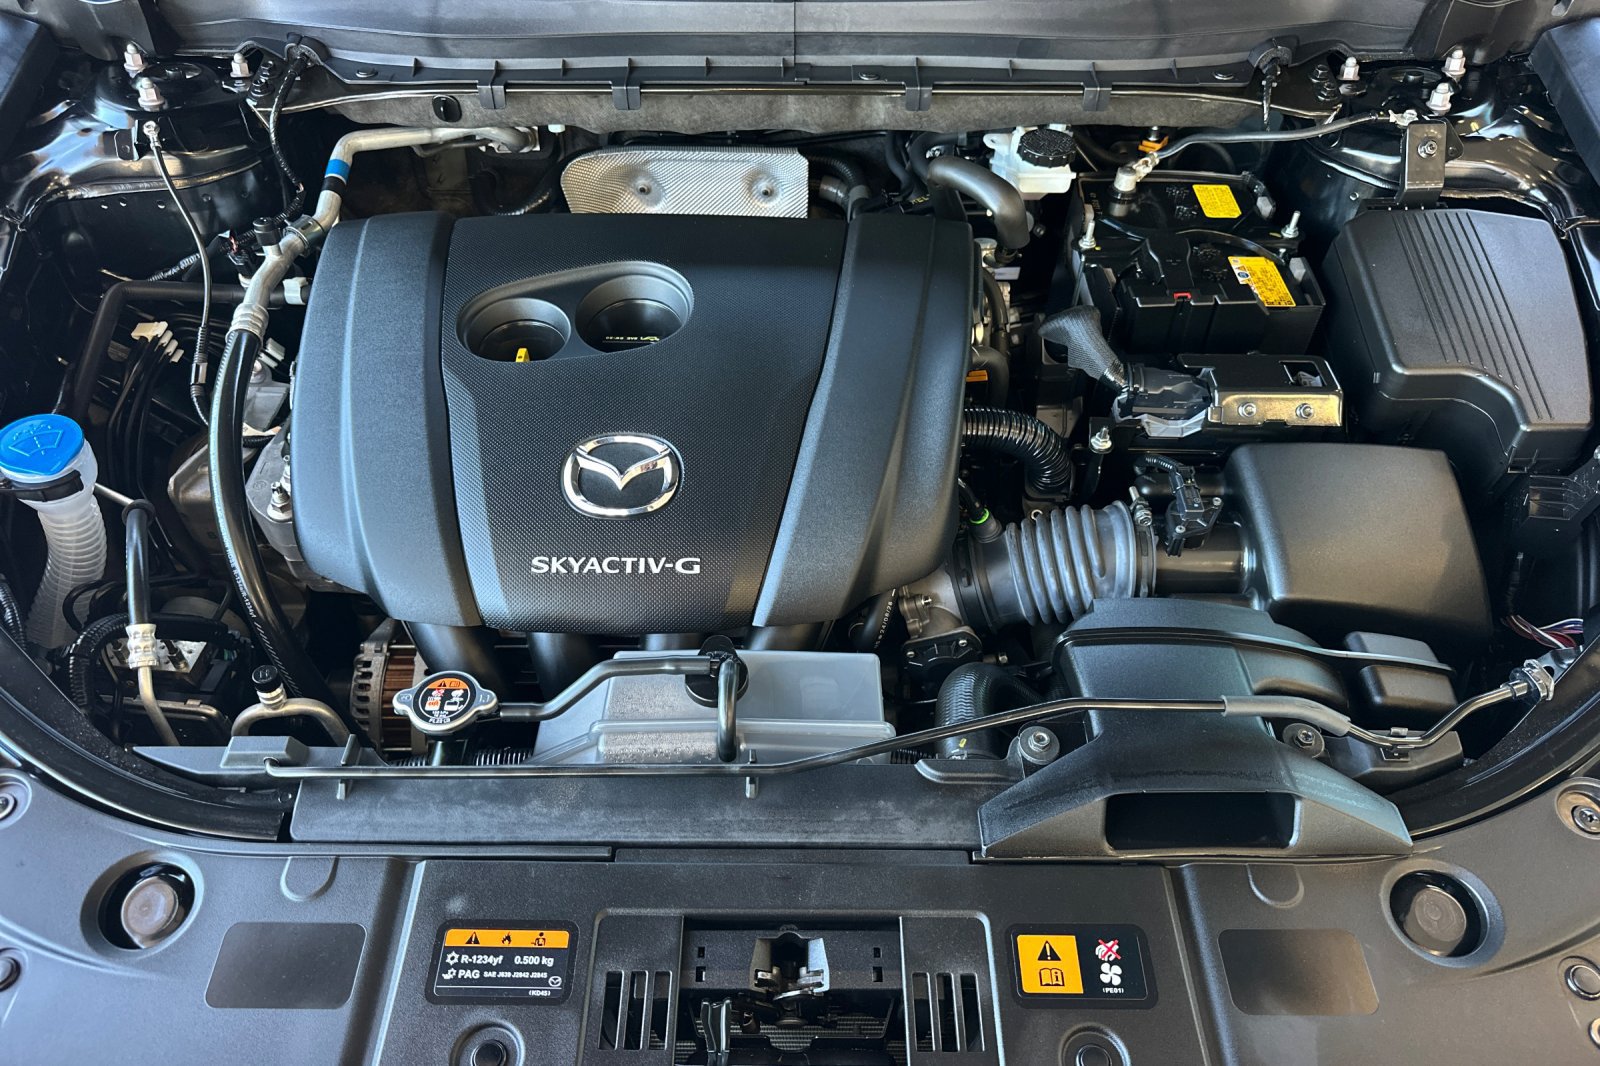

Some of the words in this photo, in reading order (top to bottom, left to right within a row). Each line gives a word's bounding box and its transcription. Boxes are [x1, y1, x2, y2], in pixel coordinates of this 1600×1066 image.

[530, 556, 701, 575] SKYACTIV-G
[460, 954, 504, 966] R-1234yf
[514, 955, 540, 965] 0.500
[541, 956, 554, 967] kg
[458, 969, 480, 979] PAG
